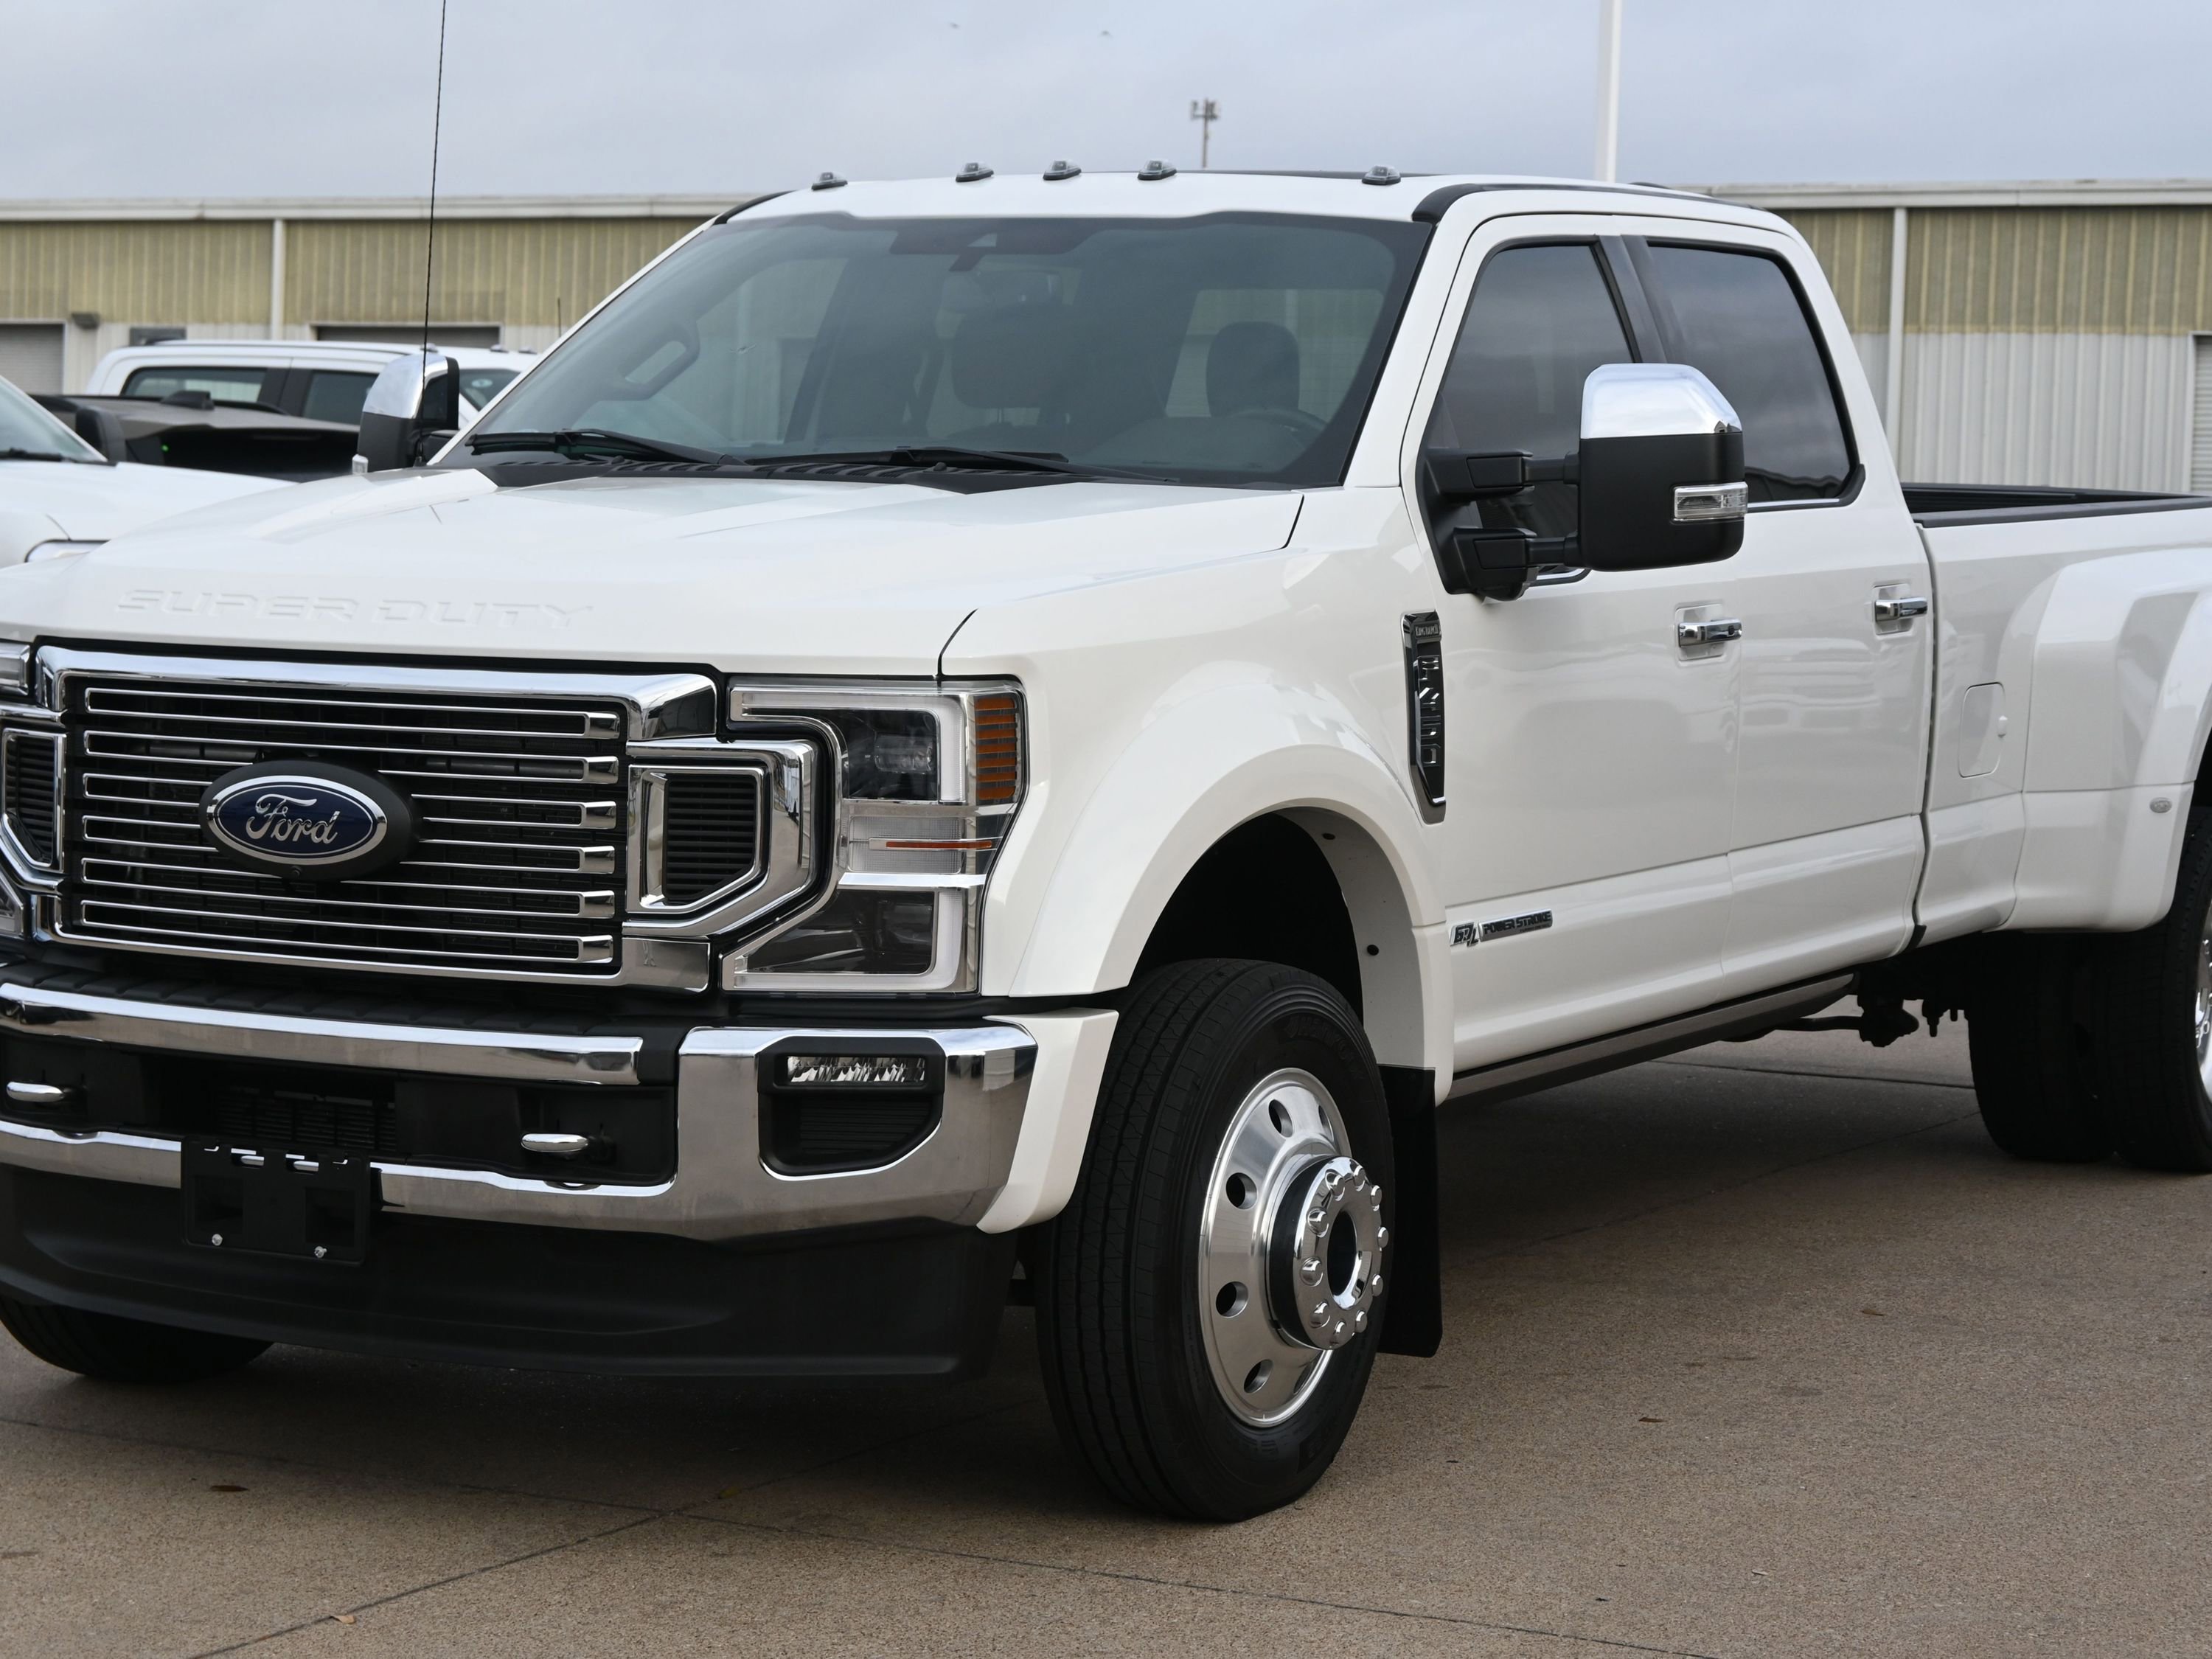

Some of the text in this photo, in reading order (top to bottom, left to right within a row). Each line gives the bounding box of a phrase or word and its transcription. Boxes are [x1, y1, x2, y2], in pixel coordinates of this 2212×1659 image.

[116, 590, 594, 629] SUPER DUTY
[246, 793, 341, 844] Ford
